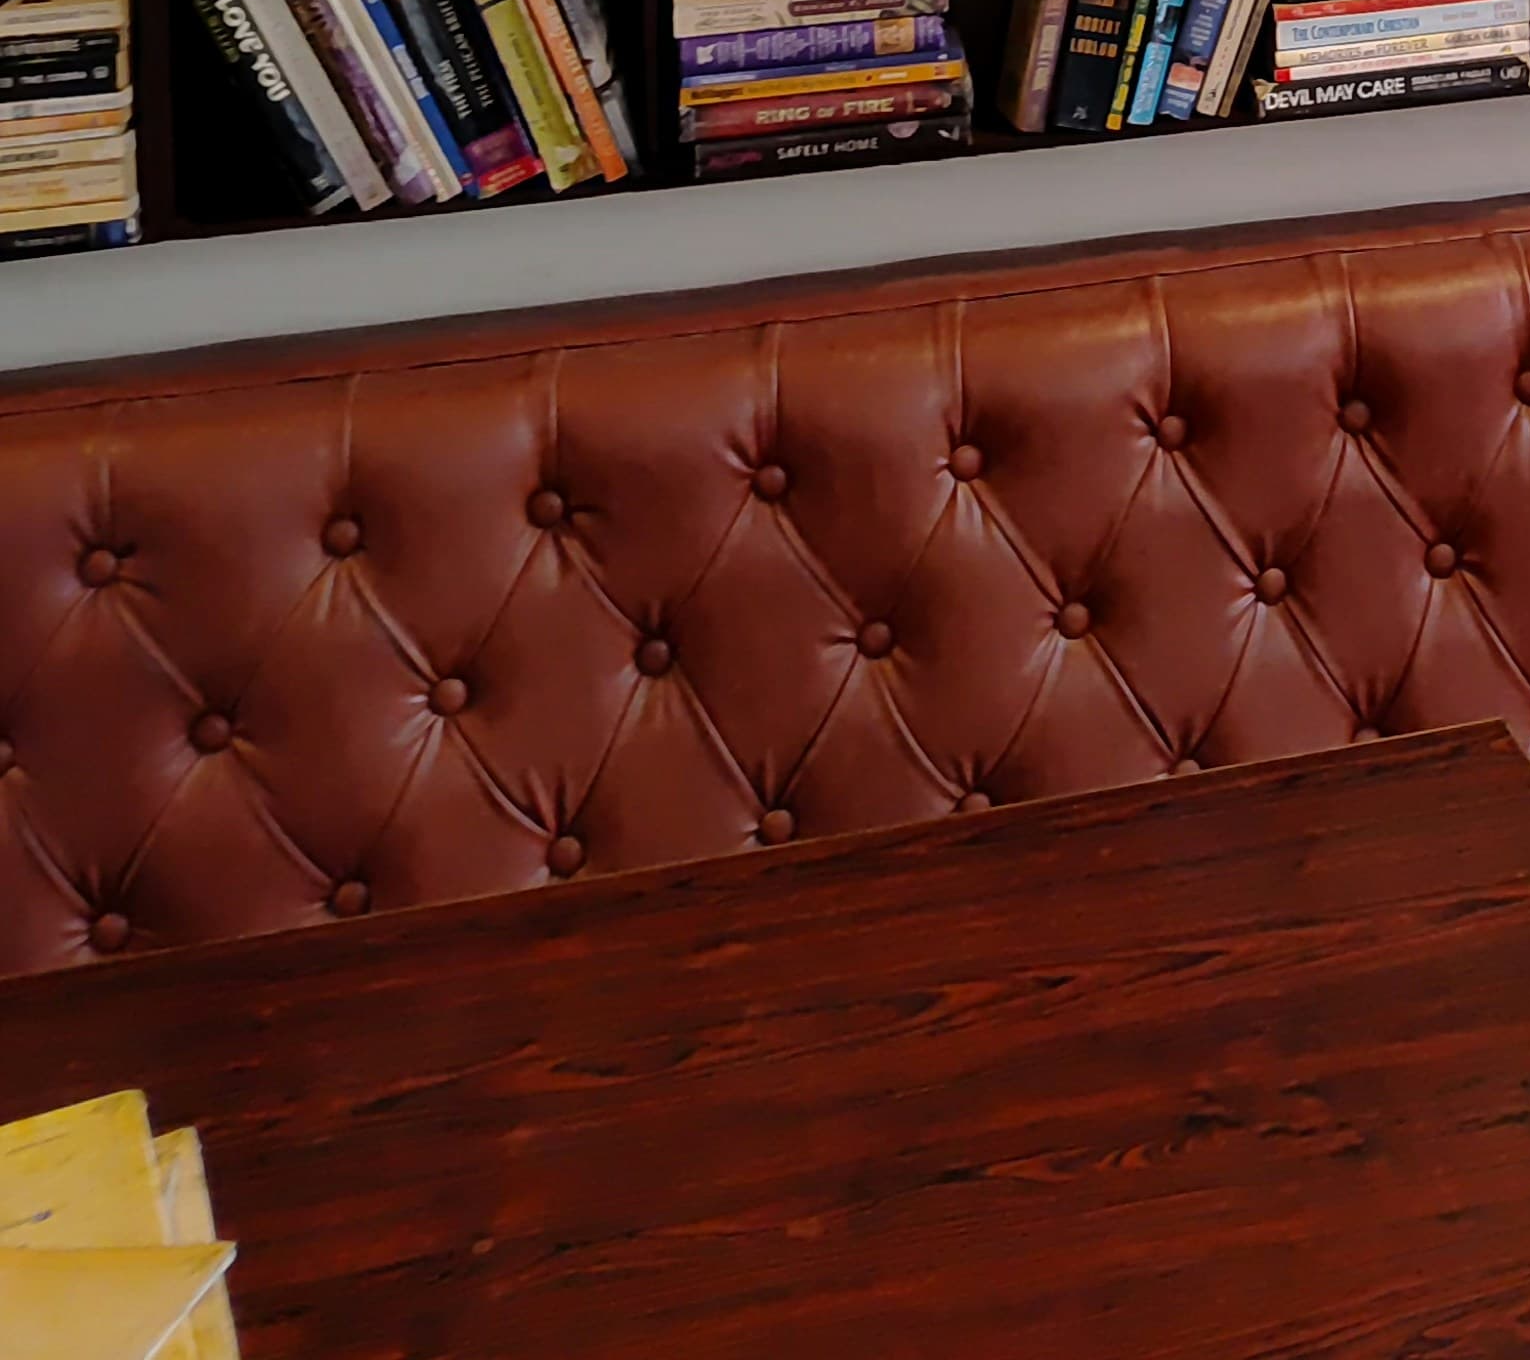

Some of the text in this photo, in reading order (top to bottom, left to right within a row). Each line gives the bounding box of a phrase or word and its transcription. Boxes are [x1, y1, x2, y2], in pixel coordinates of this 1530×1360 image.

[250, 51, 292, 103] YOU
[1263, 77, 1407, 111] DEVIL MAY CARE
[754, 106, 812, 126] RING
[841, 96, 896, 117] FIRE
[776, 136, 880, 161] SAFELY HOME
